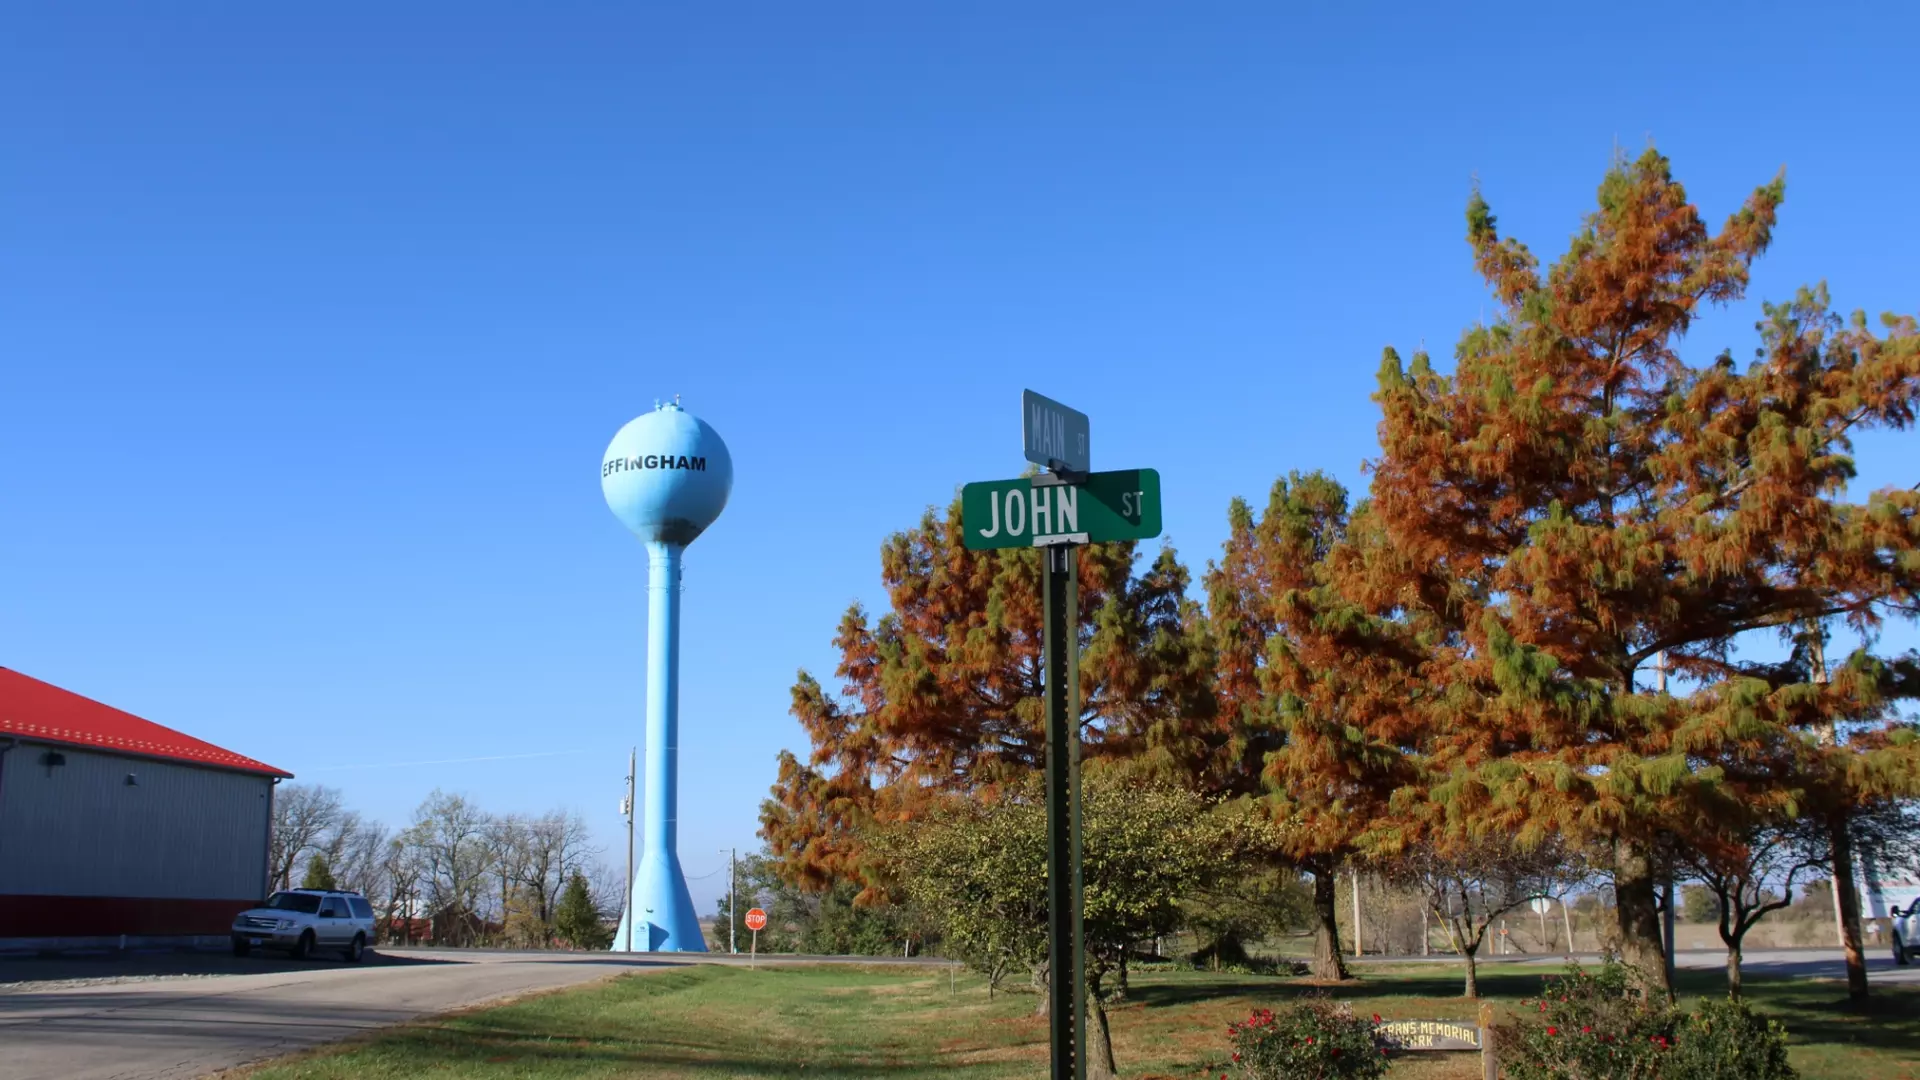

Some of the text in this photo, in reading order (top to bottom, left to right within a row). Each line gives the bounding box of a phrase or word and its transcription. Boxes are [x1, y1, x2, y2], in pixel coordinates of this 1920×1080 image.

[1032, 403, 1085, 461] MAIN ST
[603, 455, 705, 477] EFFINGHAM
[979, 484, 1143, 538] JOHN ST
[746, 914, 766, 924] STOP
